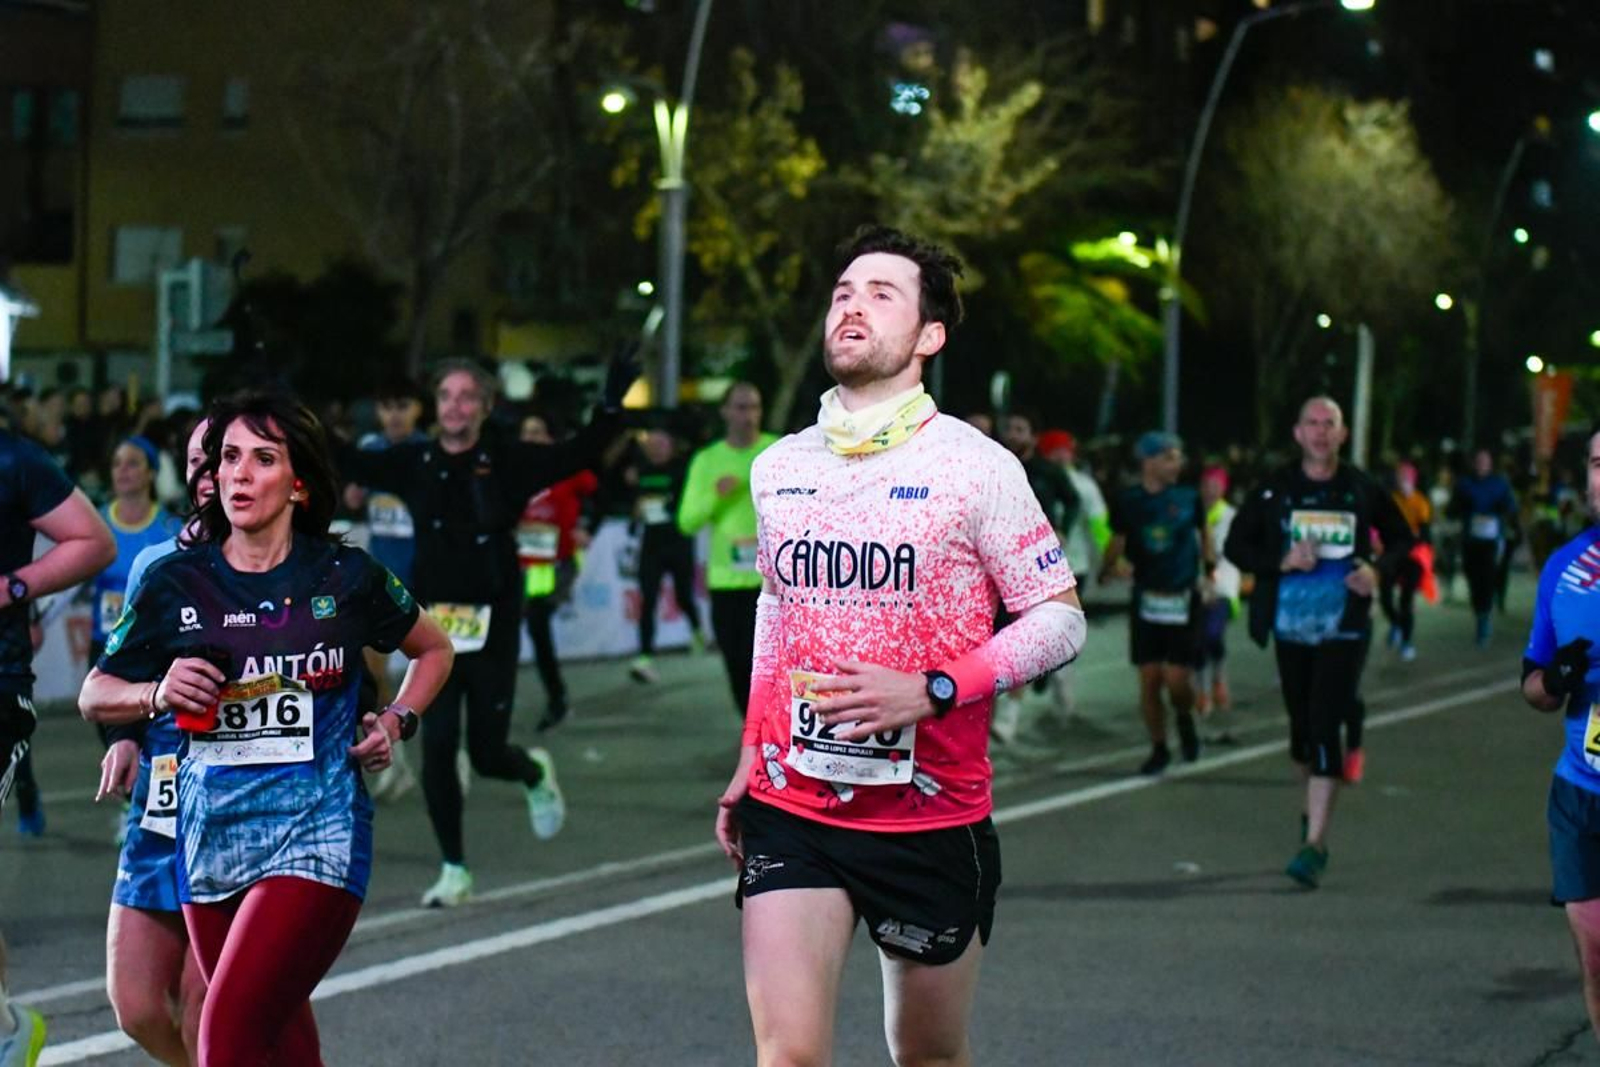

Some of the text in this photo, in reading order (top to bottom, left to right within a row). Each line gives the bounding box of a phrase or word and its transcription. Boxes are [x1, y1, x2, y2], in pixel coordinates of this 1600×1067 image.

[889, 486, 929, 500] PABLO
[775, 529, 916, 592] CÁNDIDA
[223, 604, 257, 628] jaén
[239, 642, 344, 684] ANTÓN
[212, 694, 301, 731] 816
